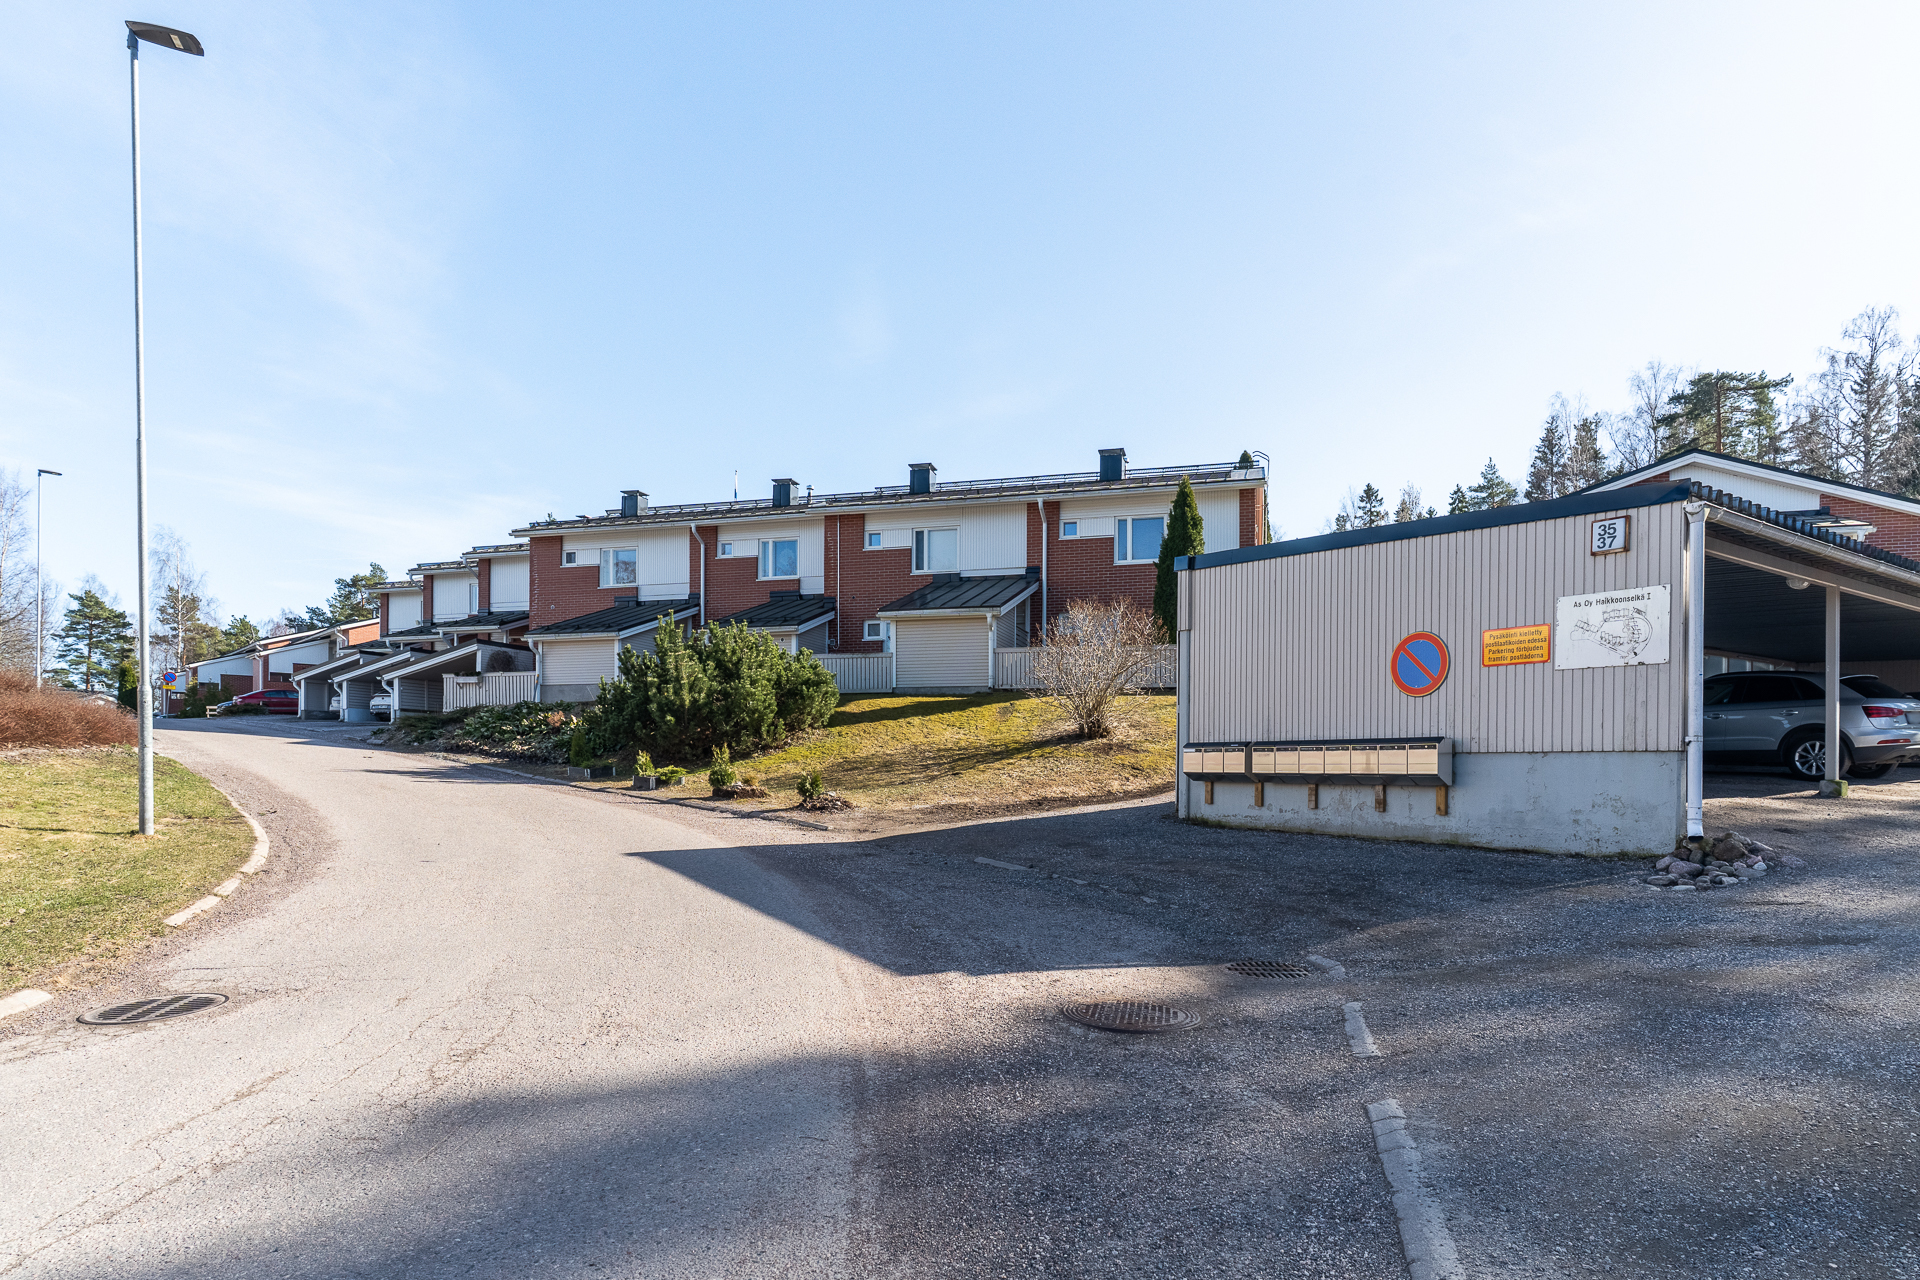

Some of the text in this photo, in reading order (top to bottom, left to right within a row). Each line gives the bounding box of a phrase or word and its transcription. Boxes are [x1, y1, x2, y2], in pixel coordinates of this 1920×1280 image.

[1598, 522, 1617, 536] 35
[1597, 535, 1617, 549] 37
[1584, 599, 1593, 607] Oy
[1595, 594, 1645, 605] Haikkoonselkä
[1647, 592, 1652, 600] I
[1489, 629, 1542, 640] Pysäköinti kielletty
[1485, 639, 1527, 648] postilaatikoiden
[1515, 645, 1544, 653] förbjuden
[1509, 653, 1544, 661] postlådorna
